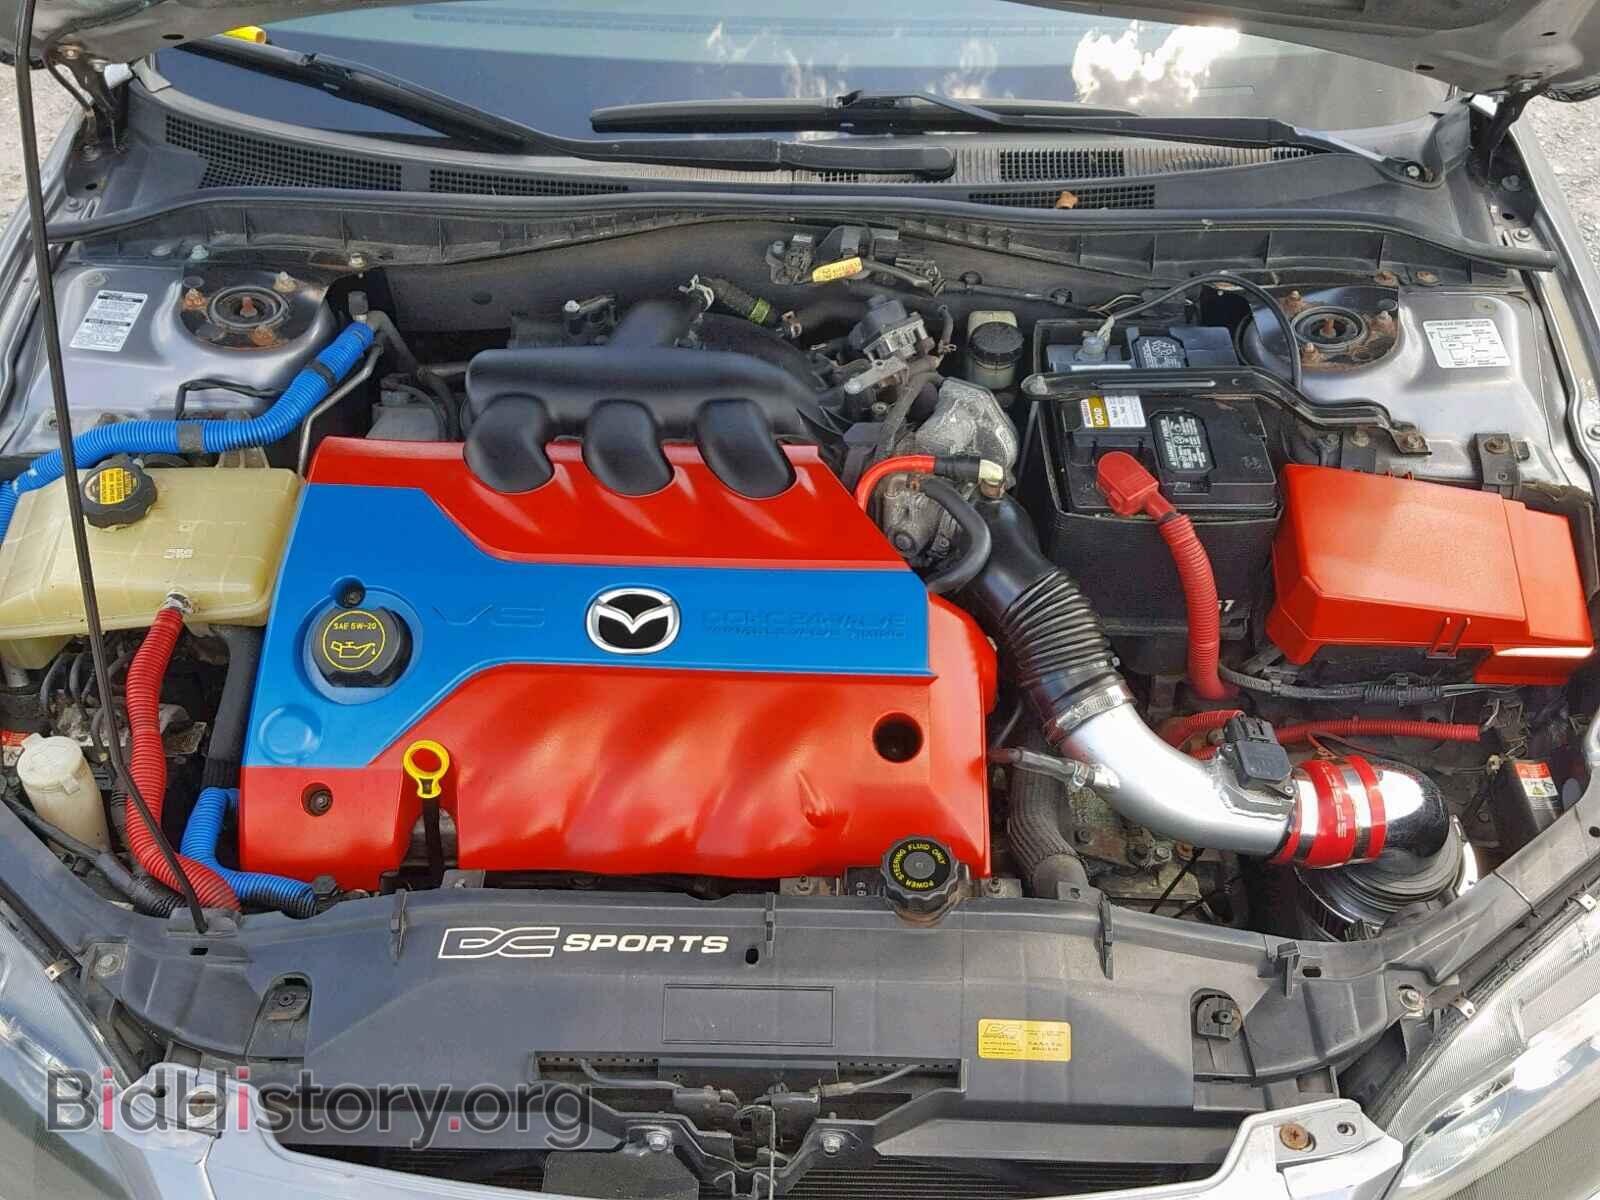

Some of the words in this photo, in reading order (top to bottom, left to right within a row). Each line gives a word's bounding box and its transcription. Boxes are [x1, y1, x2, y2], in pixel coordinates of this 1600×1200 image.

[333, 622, 350, 630] SAE
[351, 622, 377, 630] 5W-20
[907, 843, 930, 852] FLUID
[931, 848, 947, 865] ONLY
[892, 848, 907, 881] STEERING
[905, 879, 935, 890] POWER
[438, 926, 560, 959] DC
[562, 934, 729, 954] SPORTS
